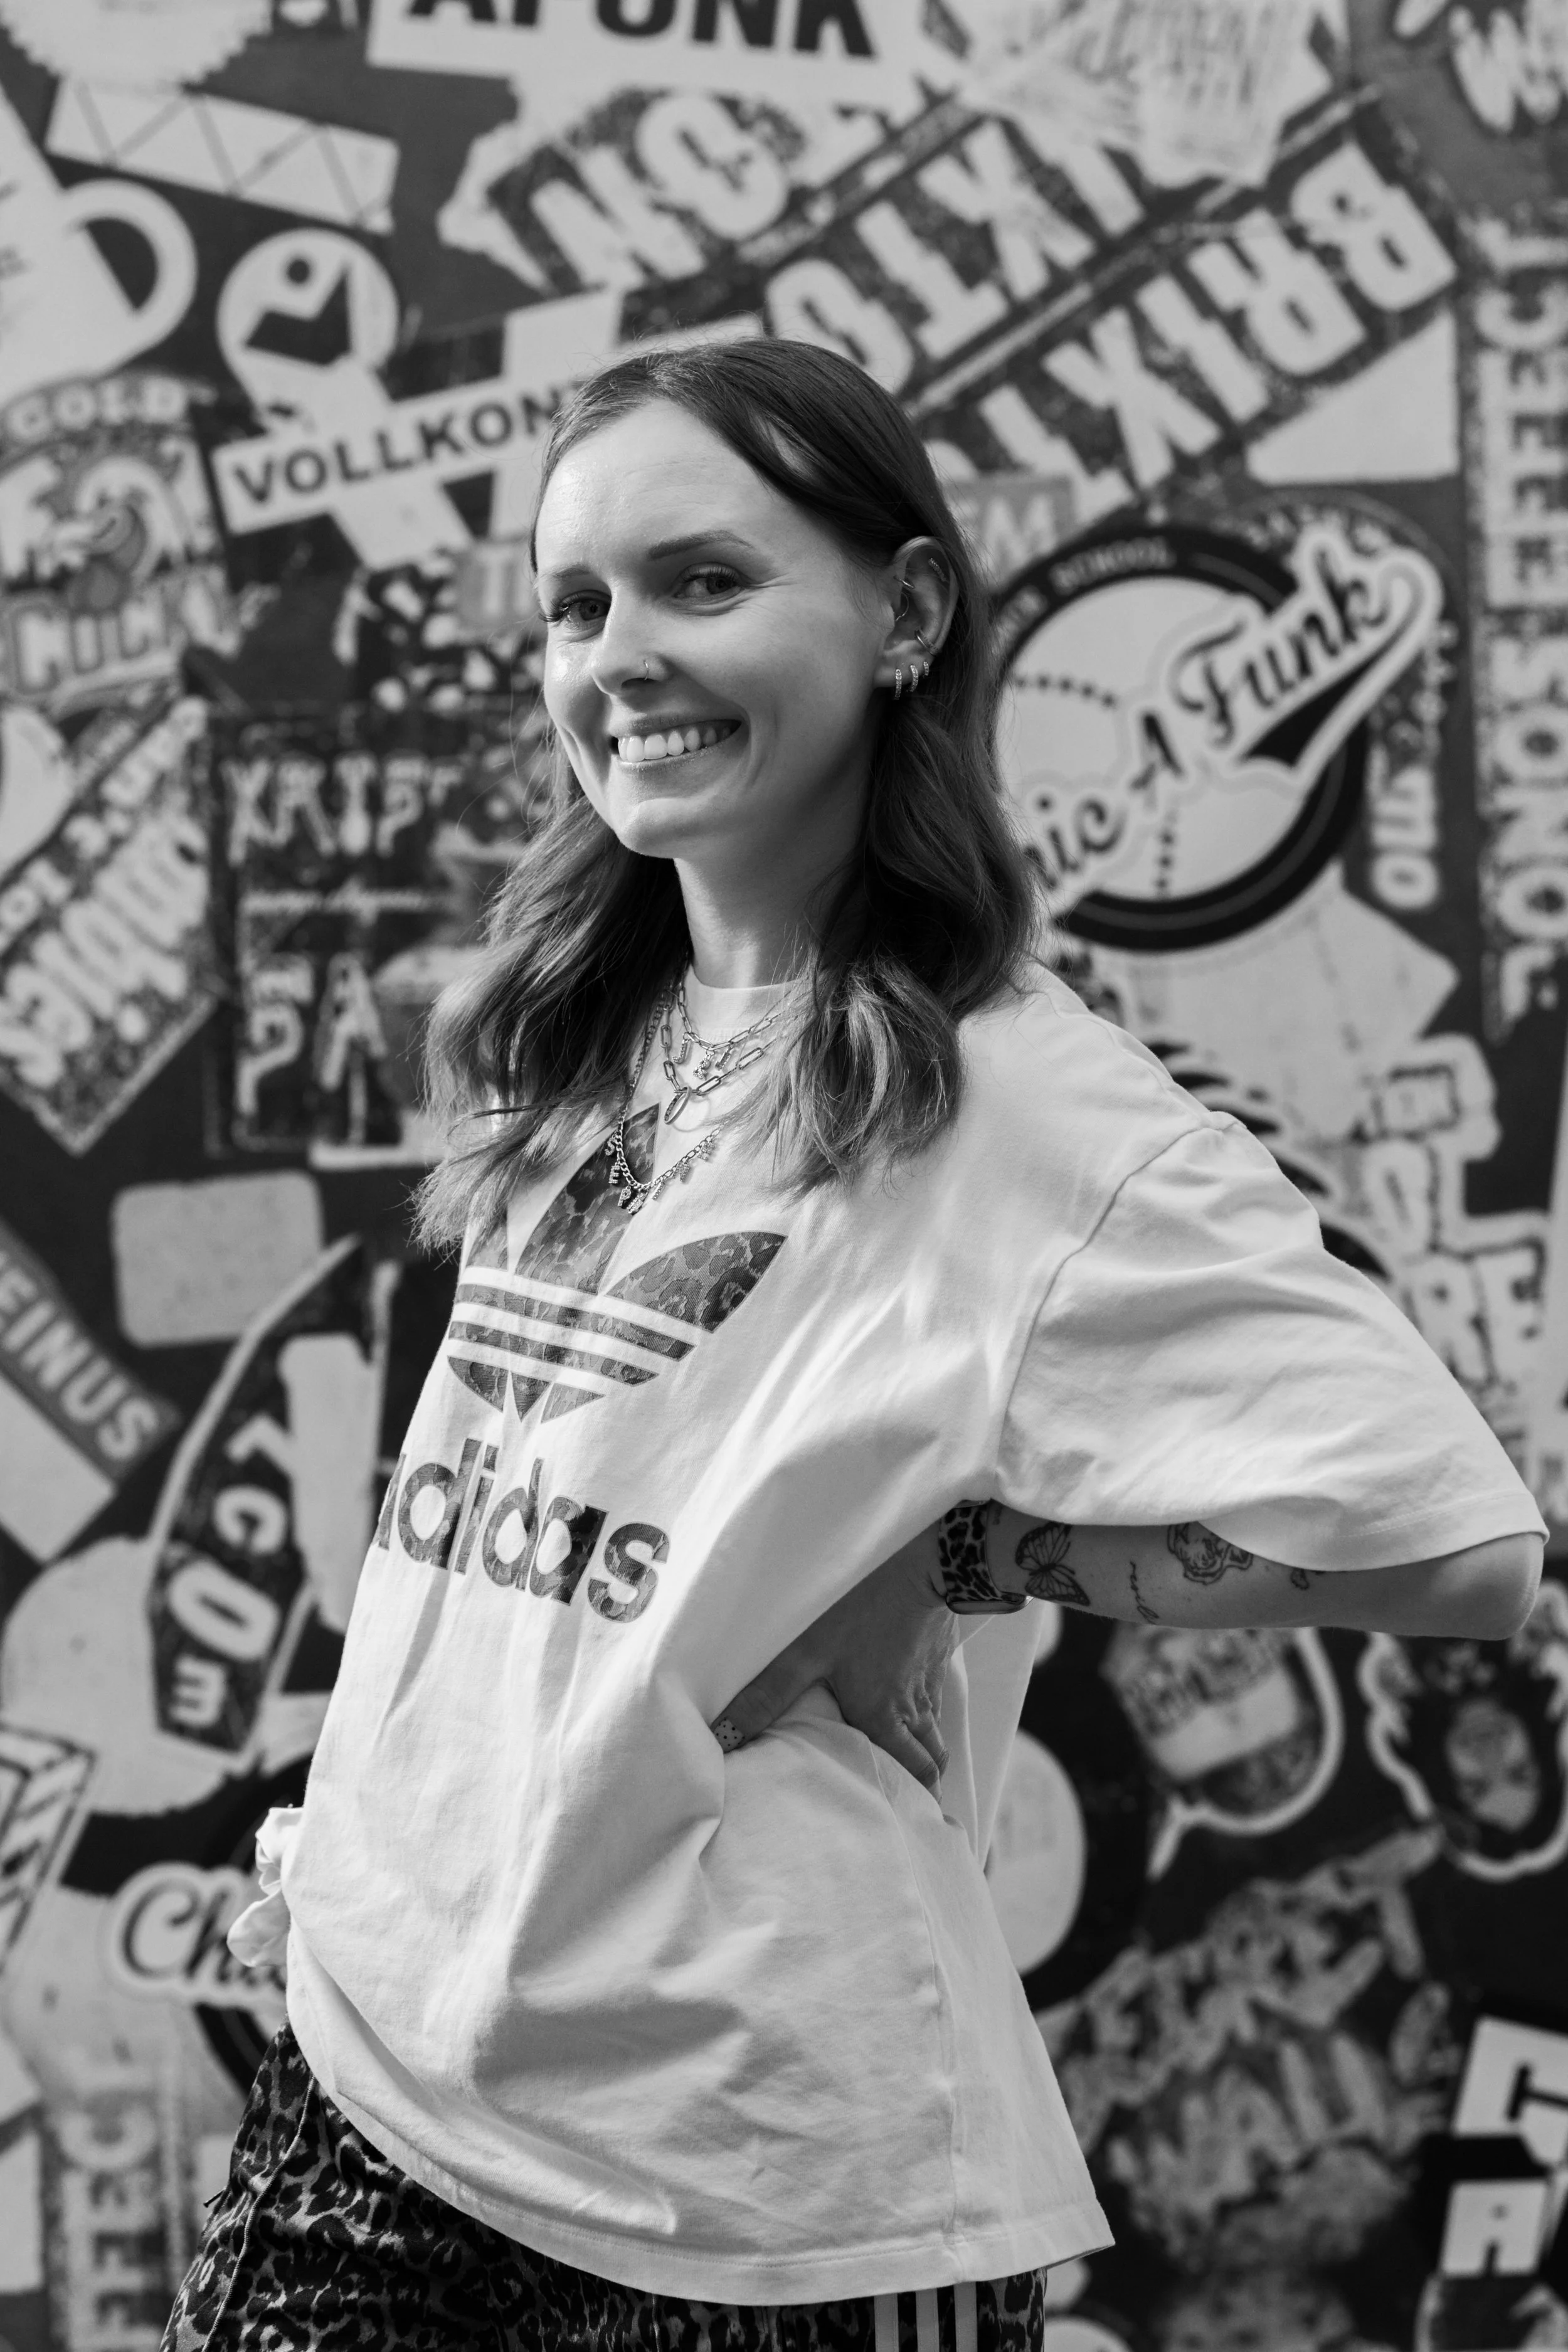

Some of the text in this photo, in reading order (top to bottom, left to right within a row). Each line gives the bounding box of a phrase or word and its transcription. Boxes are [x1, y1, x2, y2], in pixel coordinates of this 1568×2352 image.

[928, 139, 1457, 511] BRIXT
[1176, 547, 1397, 746] Funk
[378, 1438, 670, 1623] didas
[121, 1880, 287, 1990] Ch
